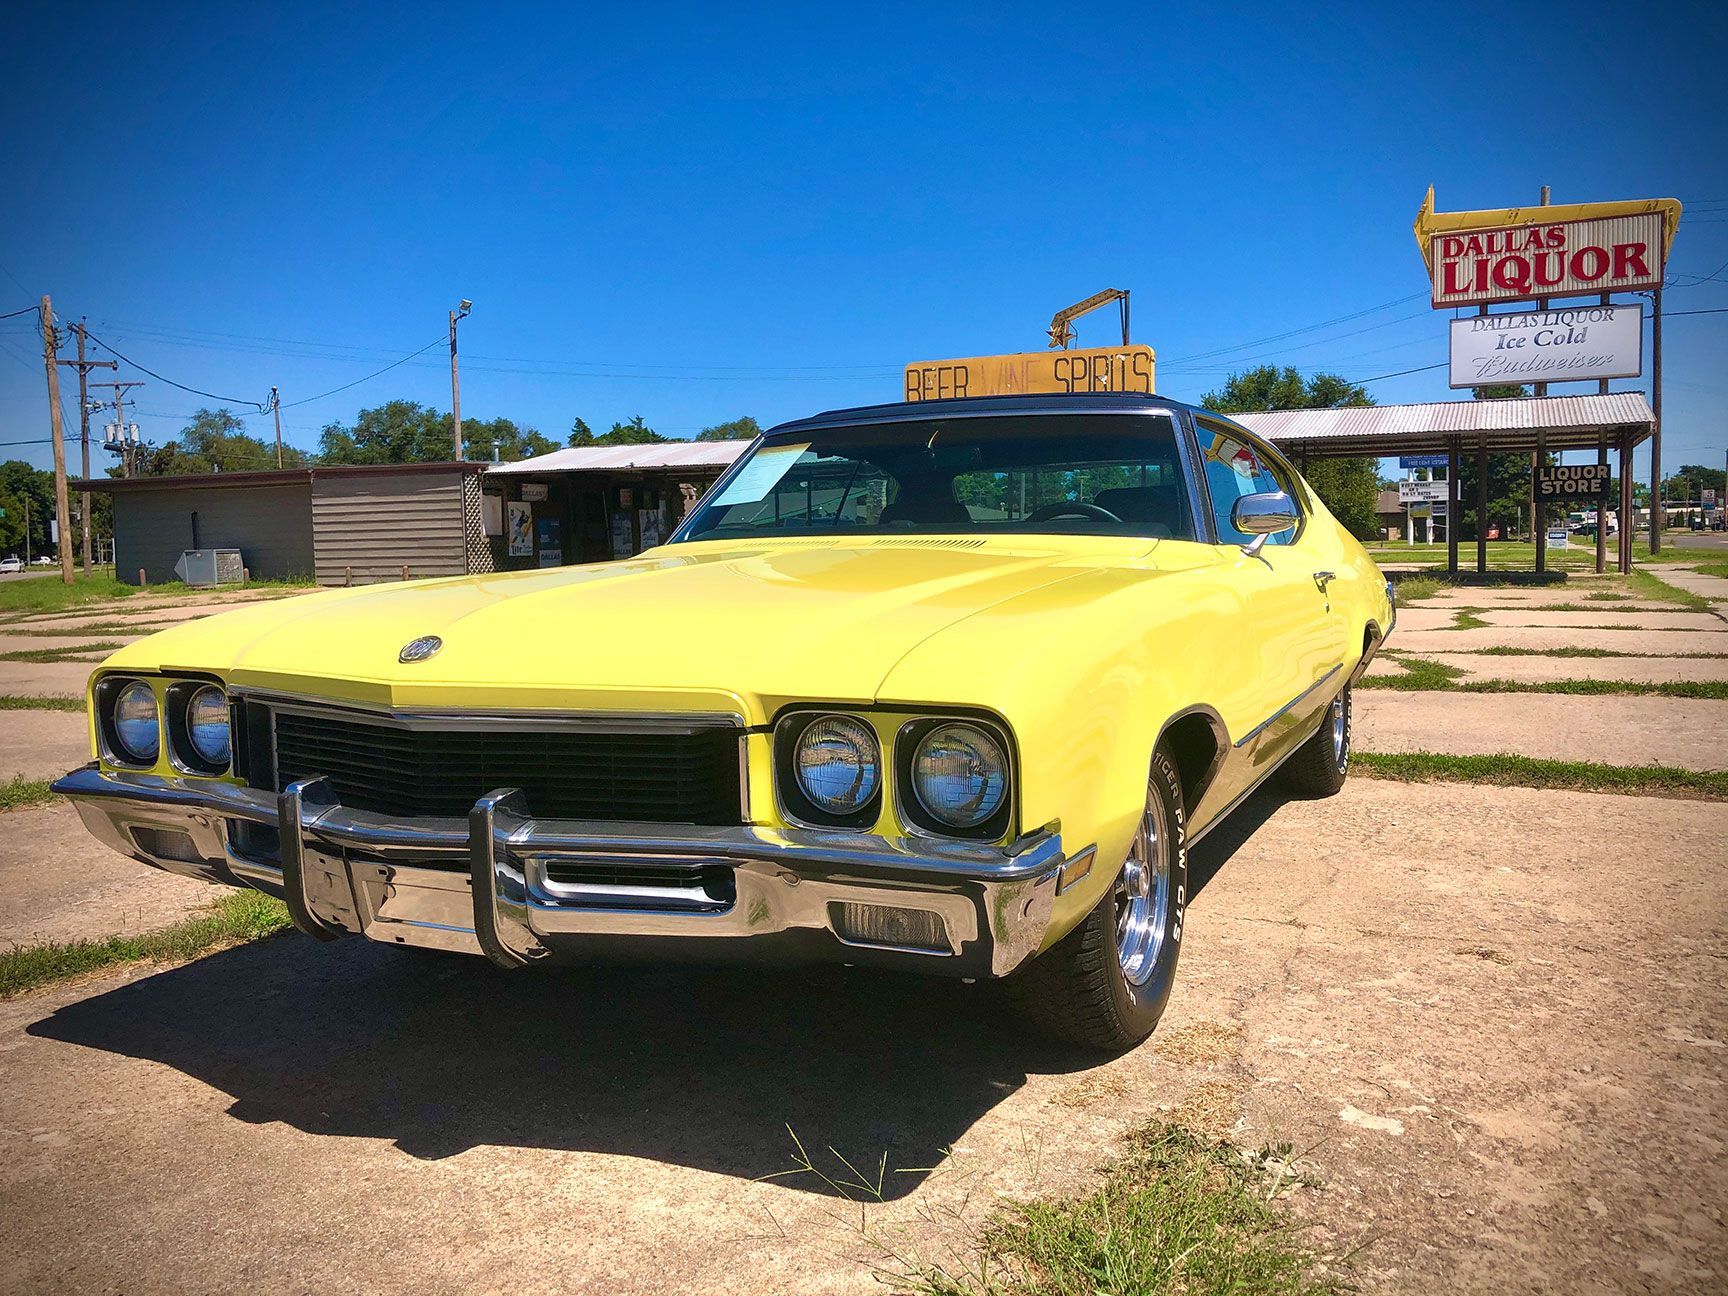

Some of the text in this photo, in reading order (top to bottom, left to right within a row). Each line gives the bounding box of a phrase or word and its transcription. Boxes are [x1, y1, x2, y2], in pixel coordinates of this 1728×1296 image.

[1443, 226, 1566, 258] DALLAS
[1443, 242, 1651, 295] LIQUOR
[1471, 308, 1614, 332] DALLAS LIQUOR
[1495, 326, 1588, 350] Ice Cold
[906, 365, 969, 401] BEER
[1054, 351, 1150, 392] SPIRITS
[1472, 351, 1614, 378] Budweiser
[1540, 465, 1608, 481] LIQUOR
[1541, 479, 1602, 495] STORE
[1153, 752, 1186, 942] TIGER PAW GTS
